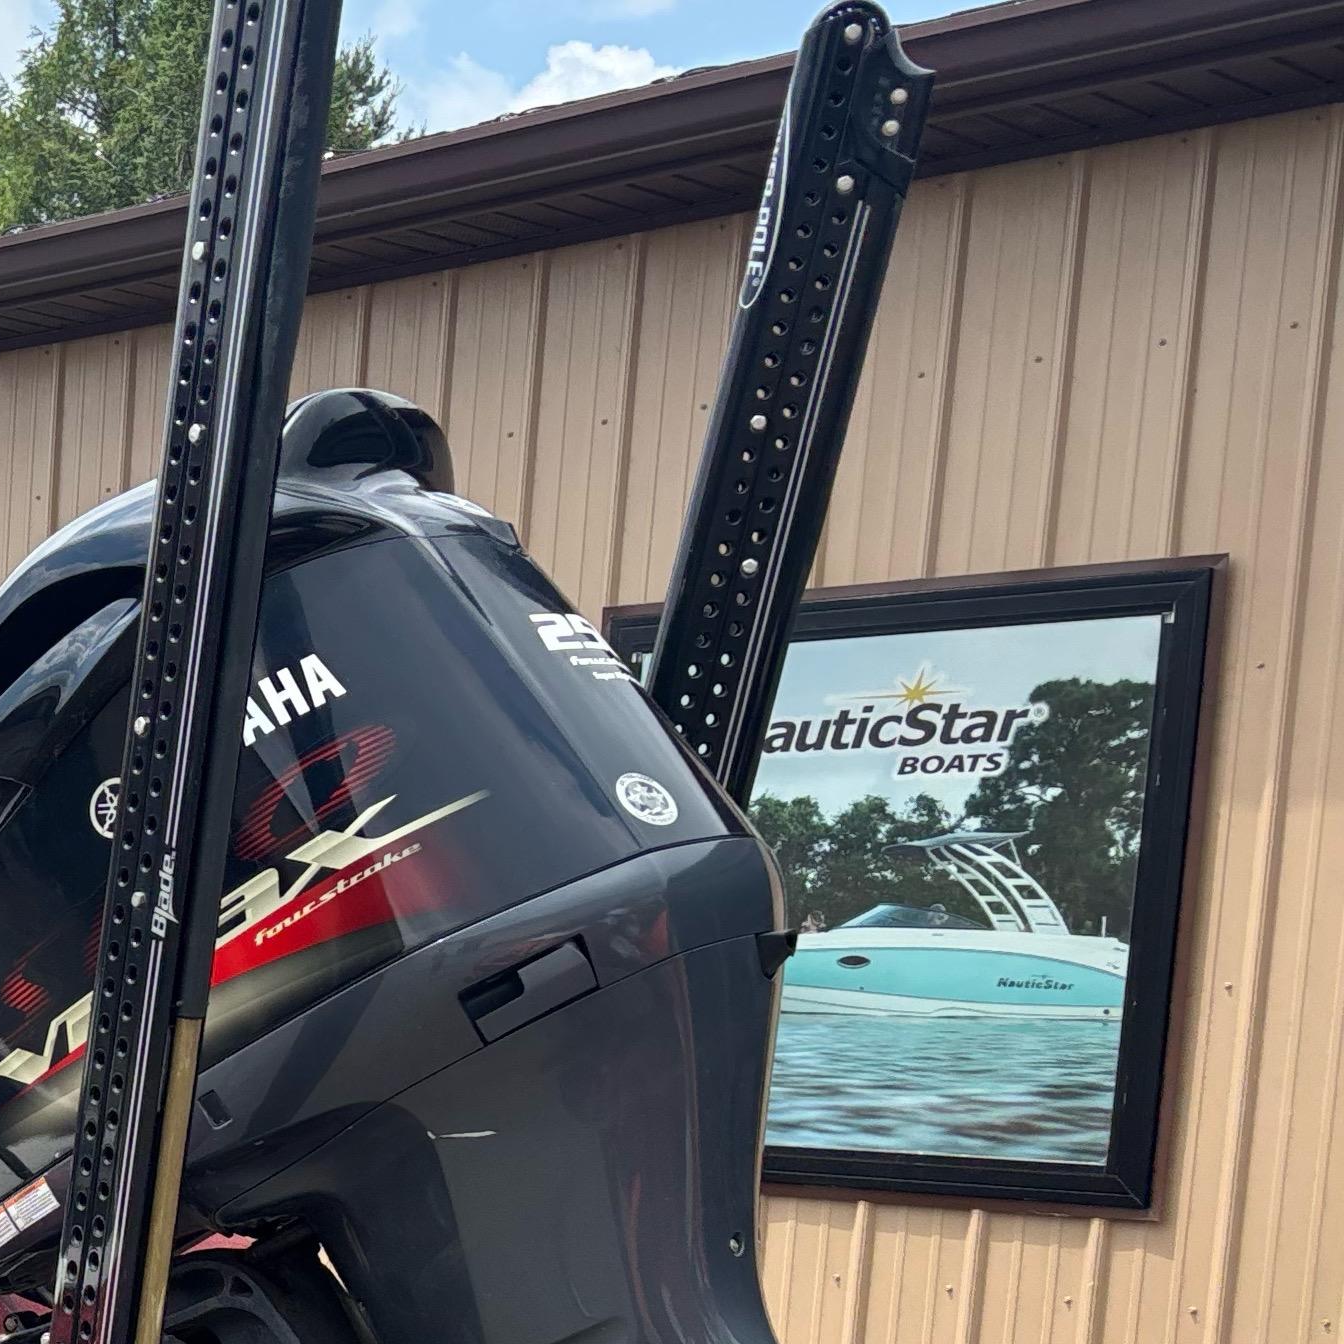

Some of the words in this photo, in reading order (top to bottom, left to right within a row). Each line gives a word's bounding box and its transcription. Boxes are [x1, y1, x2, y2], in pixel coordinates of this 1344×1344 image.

[529, 613, 620, 660] 25
[243, 653, 347, 747] AHA
[762, 703, 1030, 754] auticStar
[897, 752, 1004, 775] BOATS
[151, 854, 179, 938] Blade
[254, 843, 423, 947] fourstroke
[996, 978, 1074, 990] NauticStar
